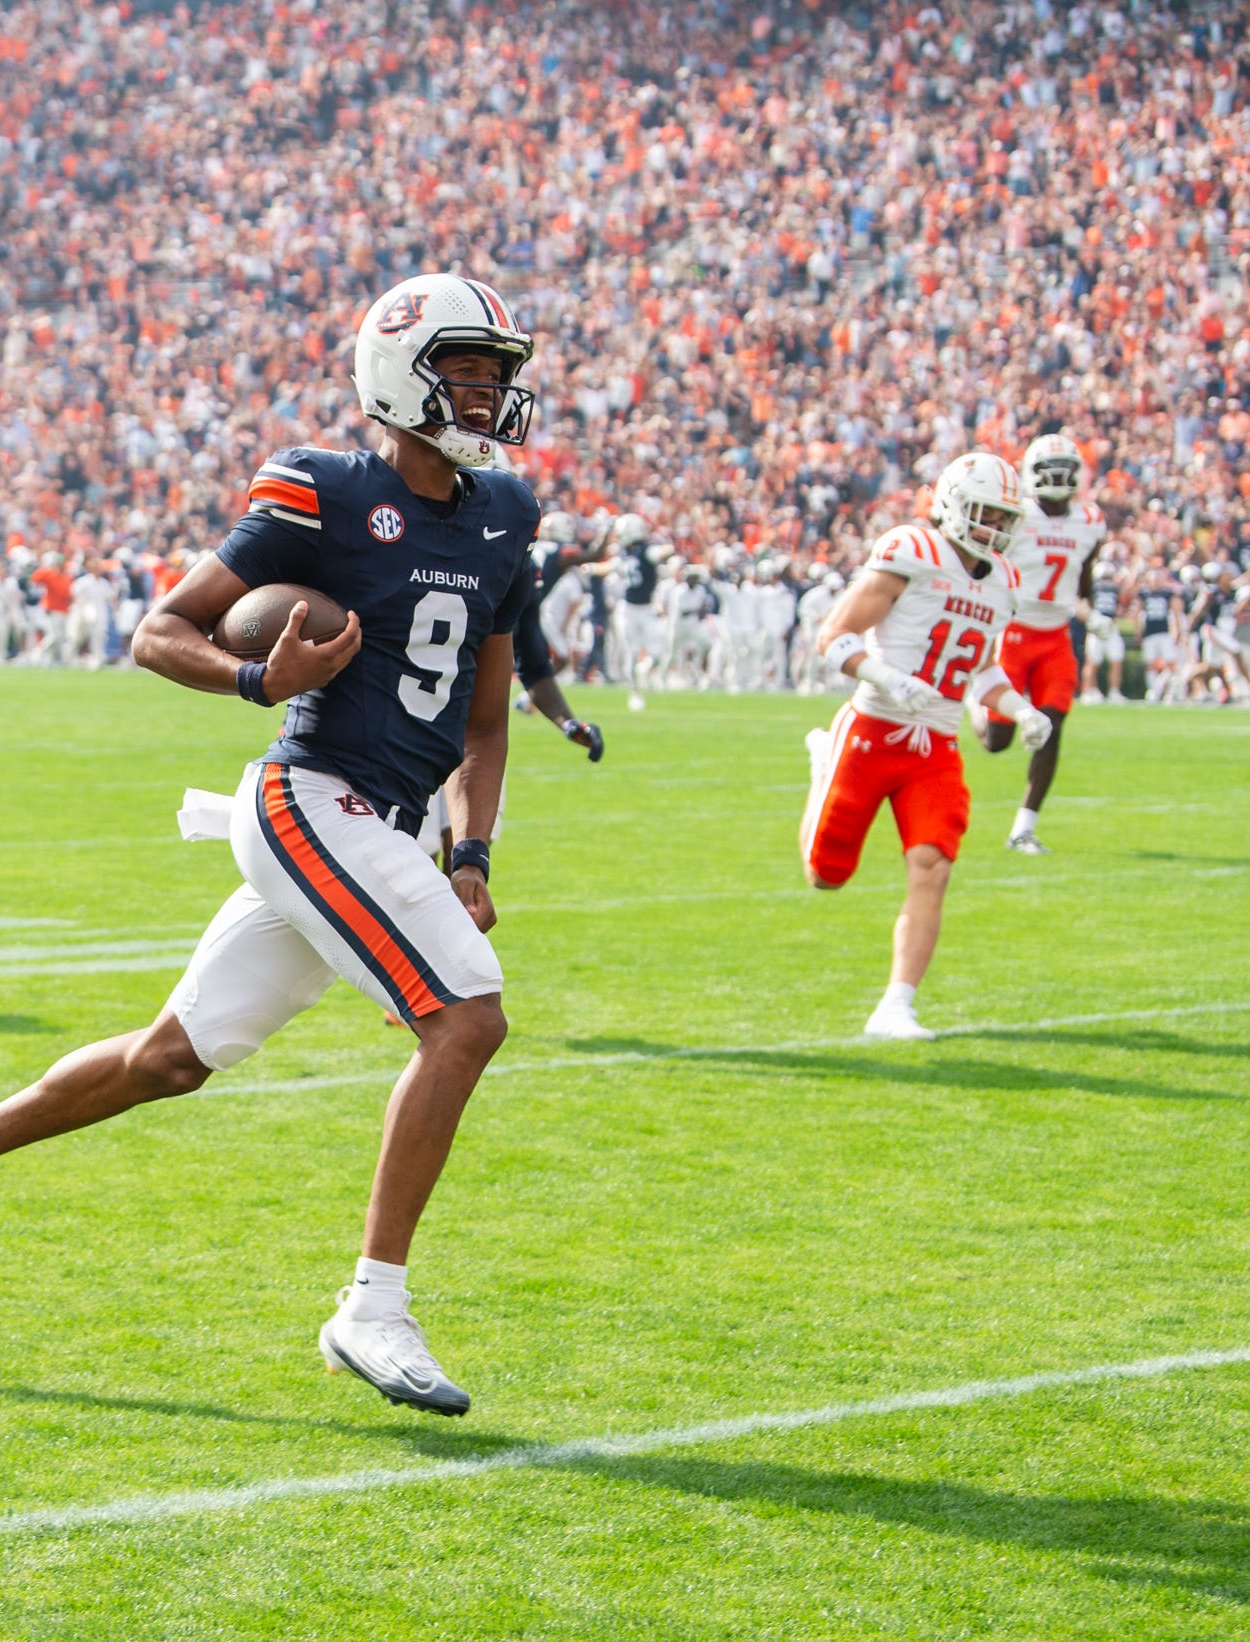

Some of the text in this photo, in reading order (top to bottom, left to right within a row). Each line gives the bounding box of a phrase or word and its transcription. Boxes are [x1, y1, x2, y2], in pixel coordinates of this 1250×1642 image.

[371, 507, 403, 540] SEC
[409, 568, 480, 590] AUBURN
[1038, 552, 1068, 602] 7
[944, 594, 996, 625] MERCER
[397, 590, 469, 722] 9
[911, 618, 987, 702] 12
